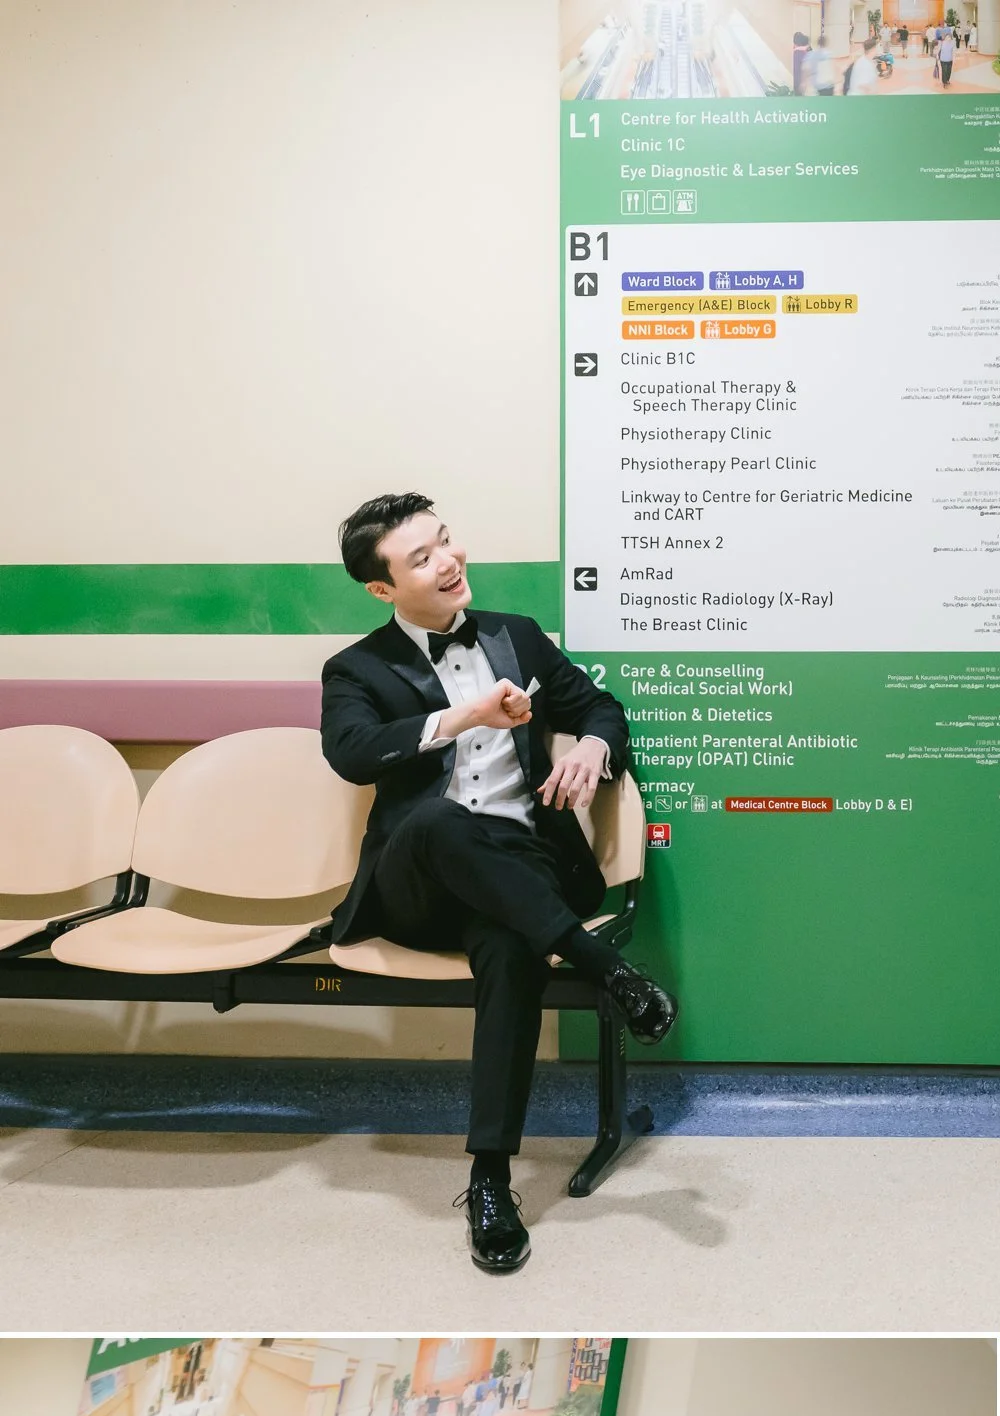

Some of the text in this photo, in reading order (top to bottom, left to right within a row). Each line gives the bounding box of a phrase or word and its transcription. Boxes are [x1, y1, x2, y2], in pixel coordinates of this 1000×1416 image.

[621, 109, 827, 125] Centre for Health Activation
[569, 112, 600, 139] L1
[621, 137, 686, 152] Clinic 1C
[621, 162, 859, 181] Eye Diagnostic & Laser Services
[676, 192, 694, 200] ATM
[569, 231, 609, 262] B1
[628, 275, 697, 288] Ward Block
[734, 274, 798, 289] Lobby A, H
[628, 298, 771, 314] Emergency (A&E) Block
[805, 298, 854, 313] Lobby R
[628, 323, 688, 337] NNI Block
[724, 323, 773, 338] Lobby G
[620, 351, 697, 366] Clinic B1C
[620, 379, 798, 398] Occupational Therapy &
[632, 397, 798, 416] Speech Therapy Clinic
[620, 426, 773, 444] Physiotherapy Clinic
[620, 456, 818, 474] Physiotherapy Pearl Clinic
[621, 488, 914, 507] Linkway to Centre for Geriatric Medicine
[633, 507, 705, 522] and CART
[621, 535, 725, 550] TTSH Annex 2
[620, 567, 674, 581] AmRad
[620, 590, 834, 609] Diagnostic Radiology (X-Ray)
[621, 617, 749, 632] The Breast Clinic
[620, 663, 765, 681] Care & Counselling
[631, 680, 794, 696] (Medical Social Work)
[624, 706, 774, 722] Nutrition & Dietetics
[625, 733, 859, 751] utpatient Parenteral Antibiotic
[632, 751, 795, 769] Therapy (OPAT) Clinic
[636, 782, 695, 796] armacy
[675, 798, 913, 813] or at Medical Centre Block Lobby D & E)
[651, 840, 666, 848] MRT
